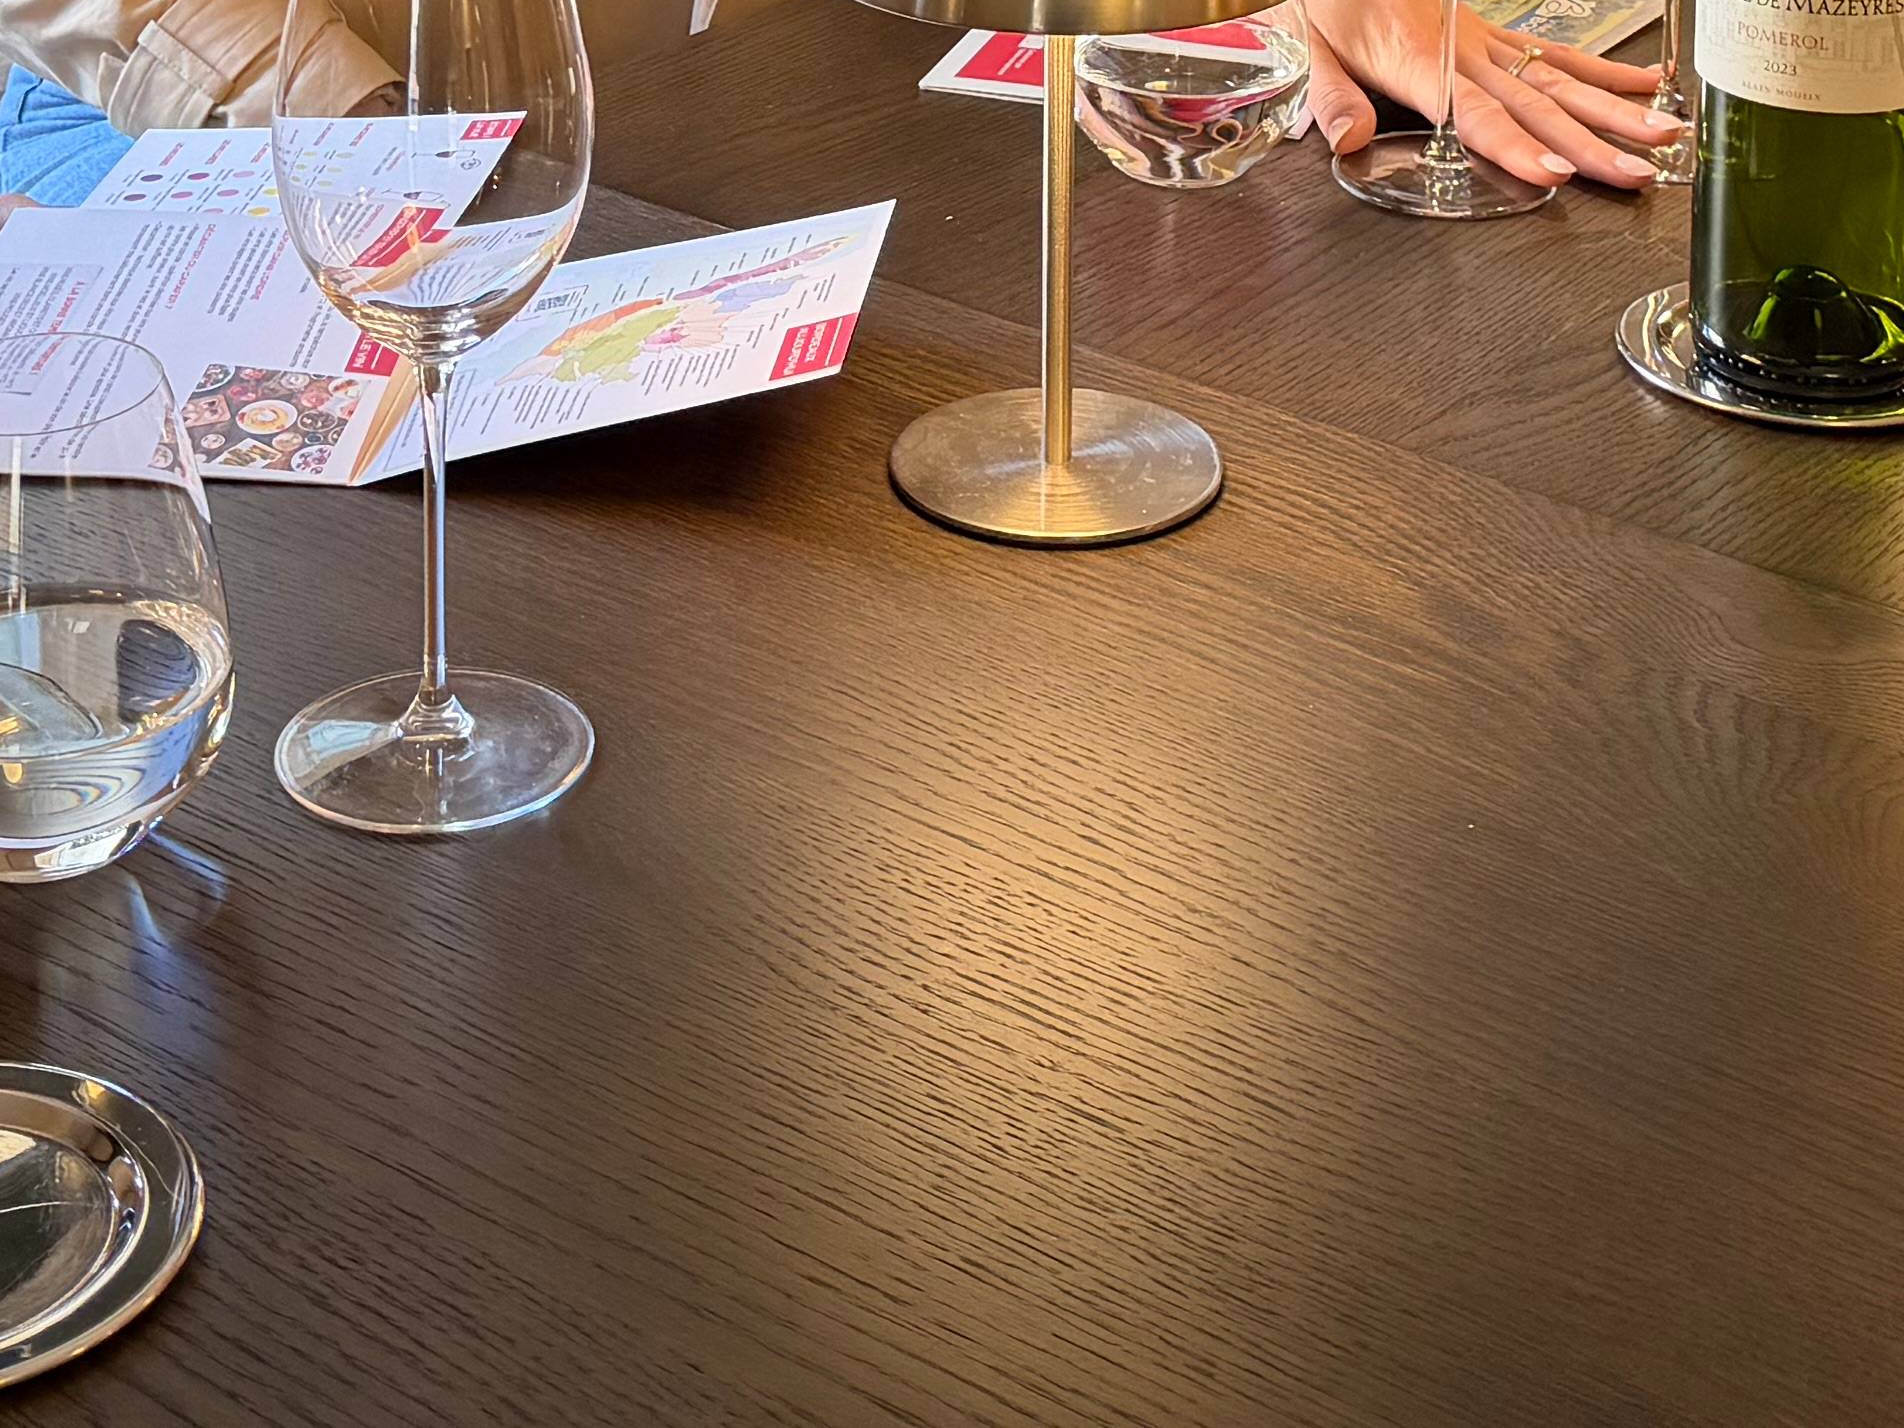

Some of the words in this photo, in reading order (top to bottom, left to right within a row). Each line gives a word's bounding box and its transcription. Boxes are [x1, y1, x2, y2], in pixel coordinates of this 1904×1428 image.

[1738, 20, 1829, 51] POMEROL
[1764, 60, 1797, 77] 2023
[360, 339, 373, 350] LE
[804, 323, 827, 362] BORDEAUX
[352, 351, 369, 368] VIN
